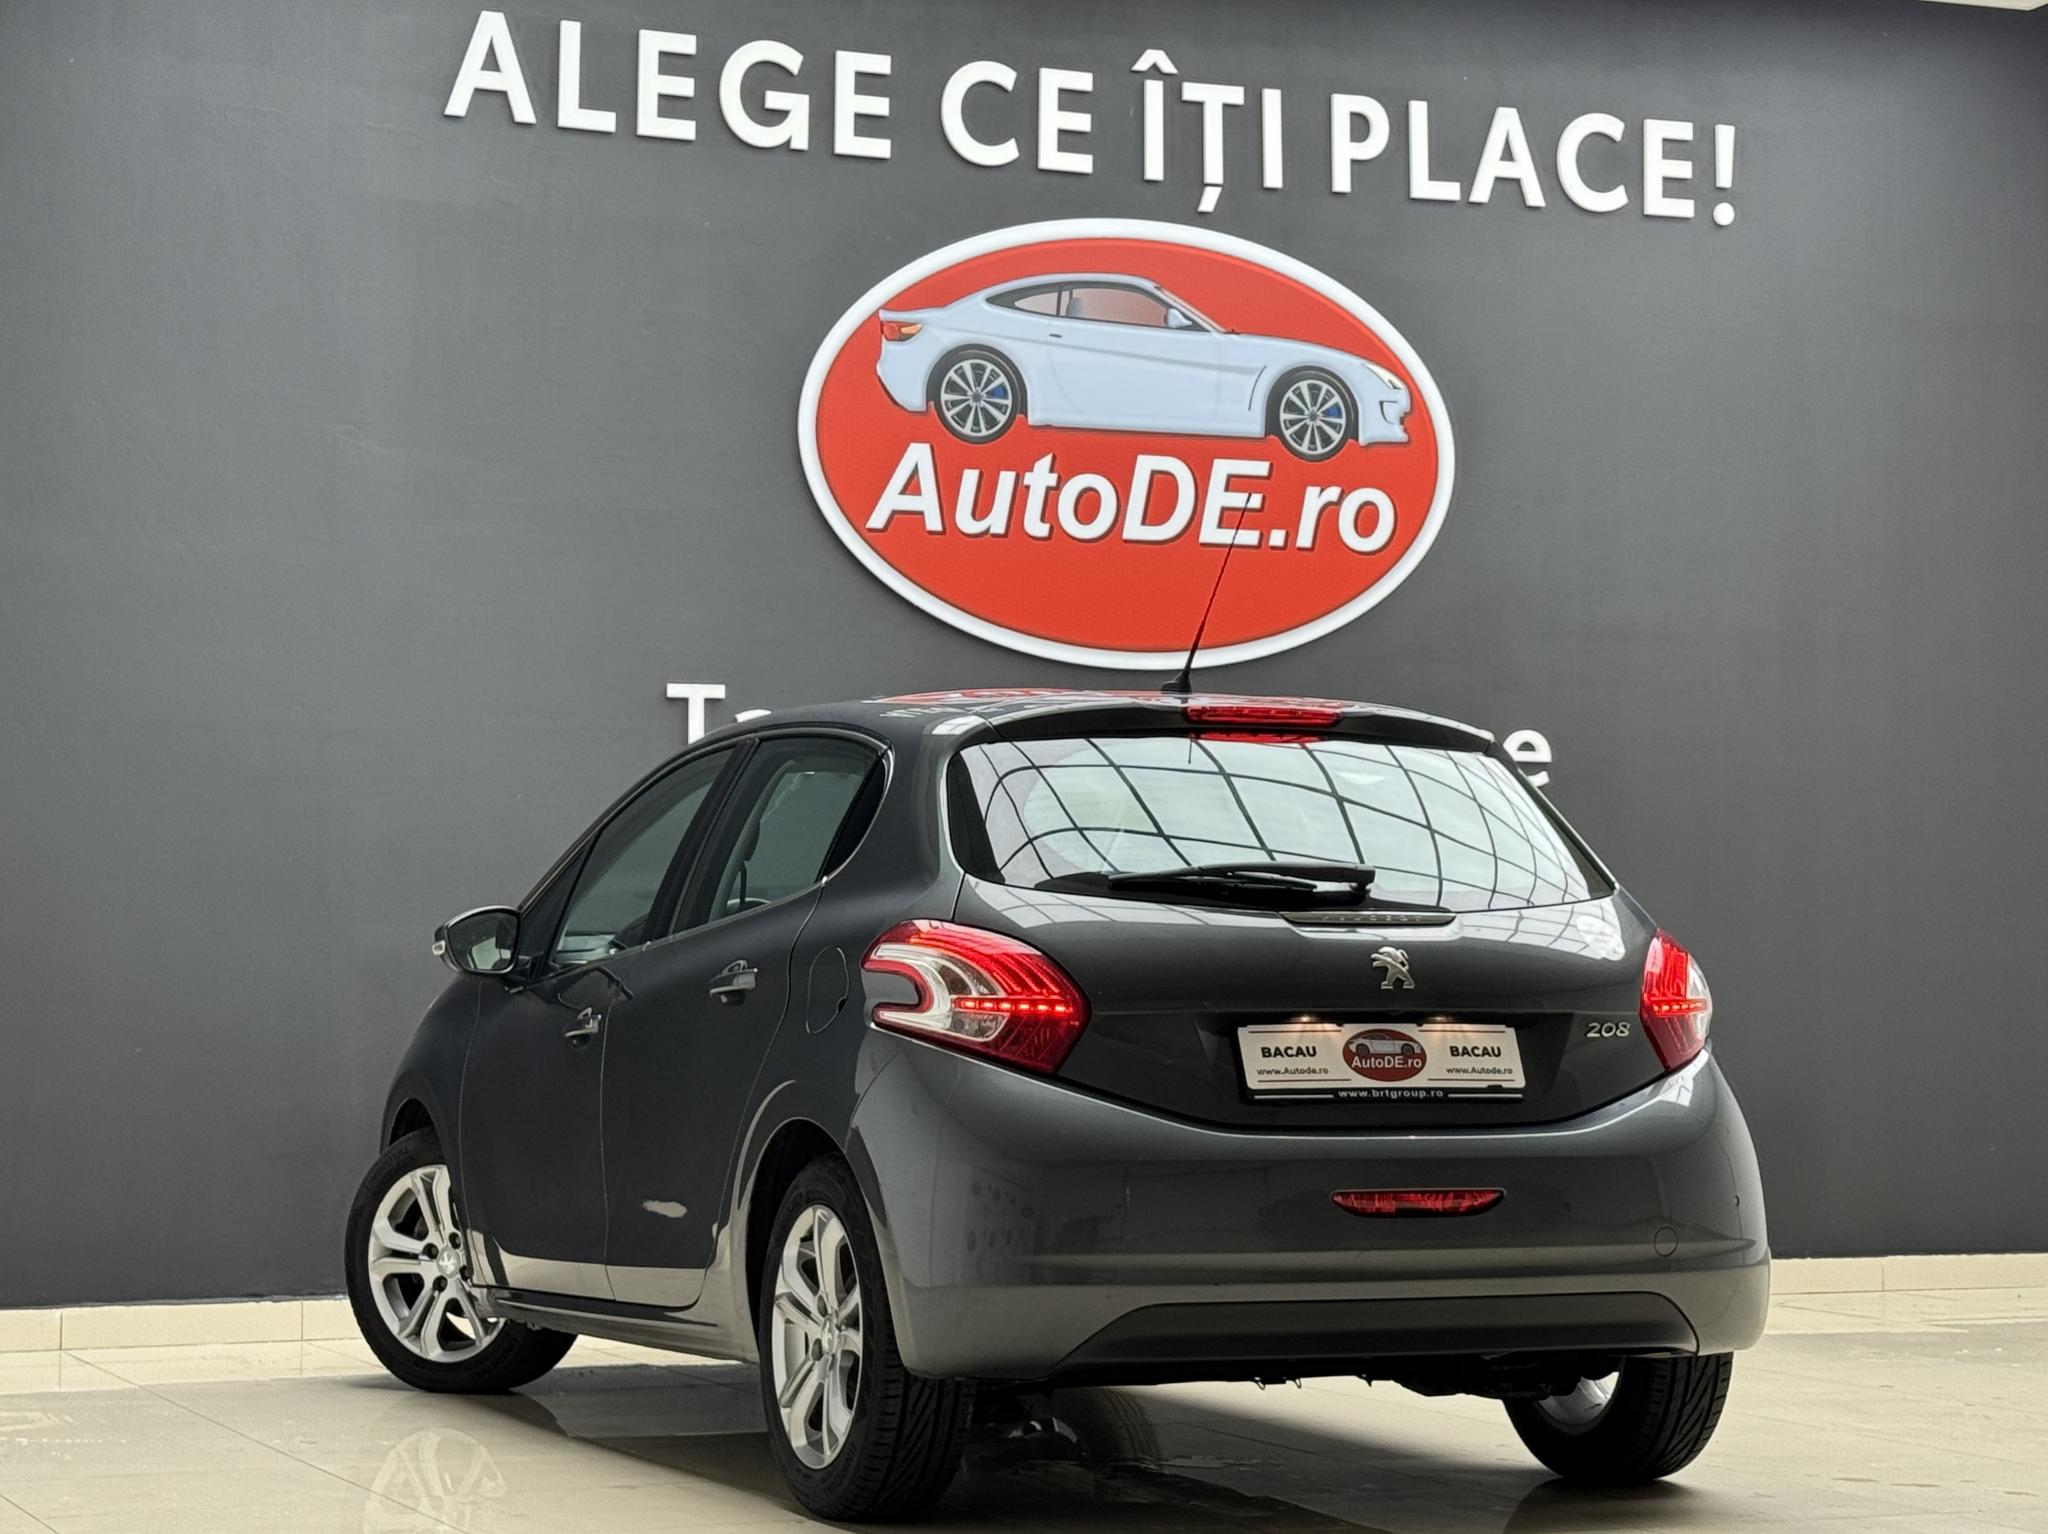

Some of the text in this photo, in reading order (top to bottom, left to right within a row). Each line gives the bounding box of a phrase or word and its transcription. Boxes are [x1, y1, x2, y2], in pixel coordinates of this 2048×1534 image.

[443, 9, 892, 159] ALEGE
[940, 60, 1094, 175] CE
[1330, 93, 1736, 227] PLACE!
[865, 442, 1397, 555] AutoDE.ro
[1586, 1021, 1630, 1038] 208
[1260, 1045, 1318, 1059] BACAU
[1449, 1045, 1502, 1058] BACAU
[1351, 1055, 1423, 1069] AutoDE.ro
[1256, 1066, 1329, 1076] www.Autode.ro
[1445, 1066, 1513, 1075] www.Autode.ro
[1337, 1088, 1444, 1099] www.brtgroup.ro
